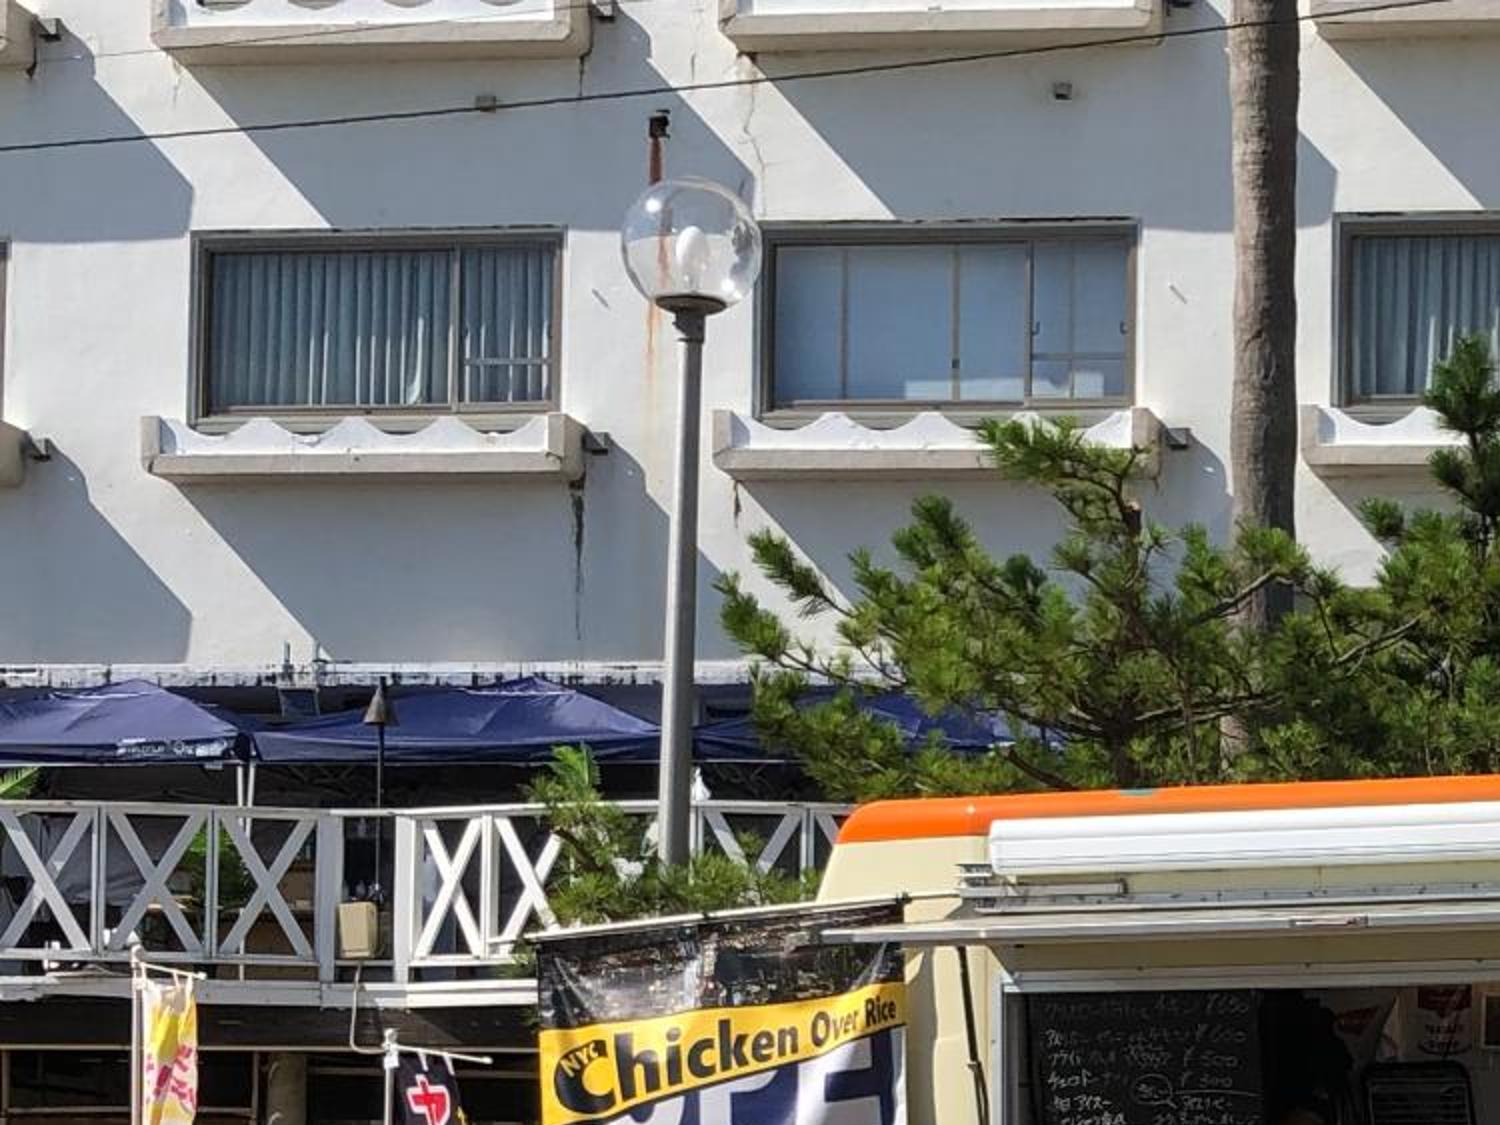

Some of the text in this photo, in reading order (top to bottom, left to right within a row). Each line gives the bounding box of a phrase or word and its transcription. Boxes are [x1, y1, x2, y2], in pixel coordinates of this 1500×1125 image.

[554, 996, 896, 1114] NYC Chicken Over Rice
